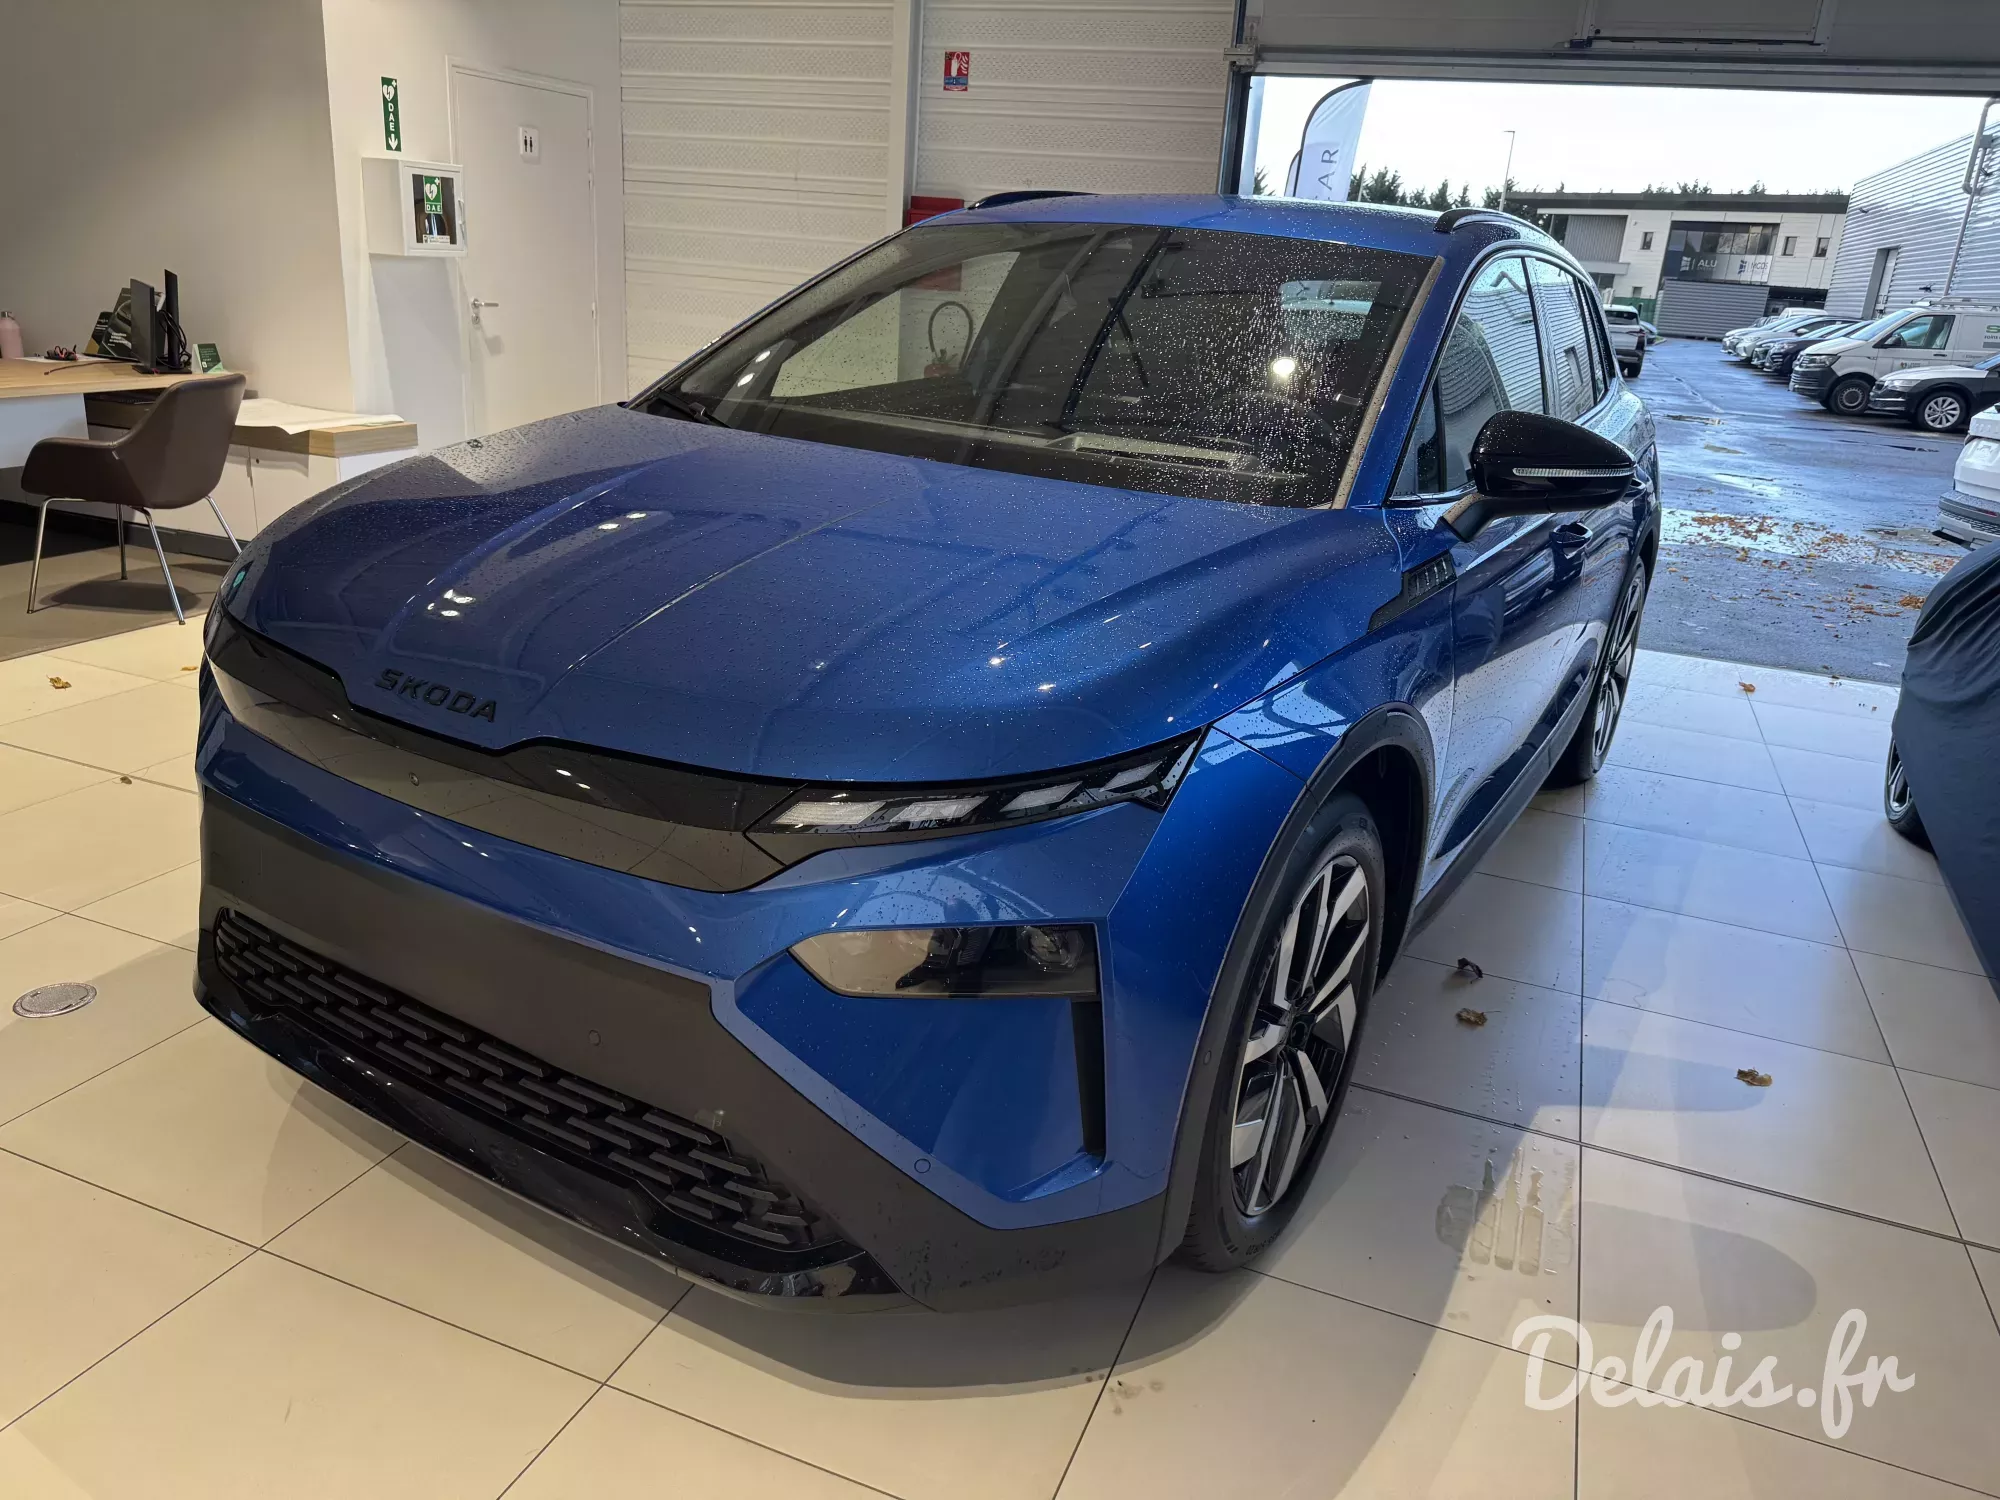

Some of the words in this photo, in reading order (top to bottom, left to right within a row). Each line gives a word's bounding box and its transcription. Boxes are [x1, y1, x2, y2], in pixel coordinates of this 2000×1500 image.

[1315, 149, 1339, 200] AR
[426, 204, 441, 212] DAE
[1697, 259, 1718, 268] ALU
